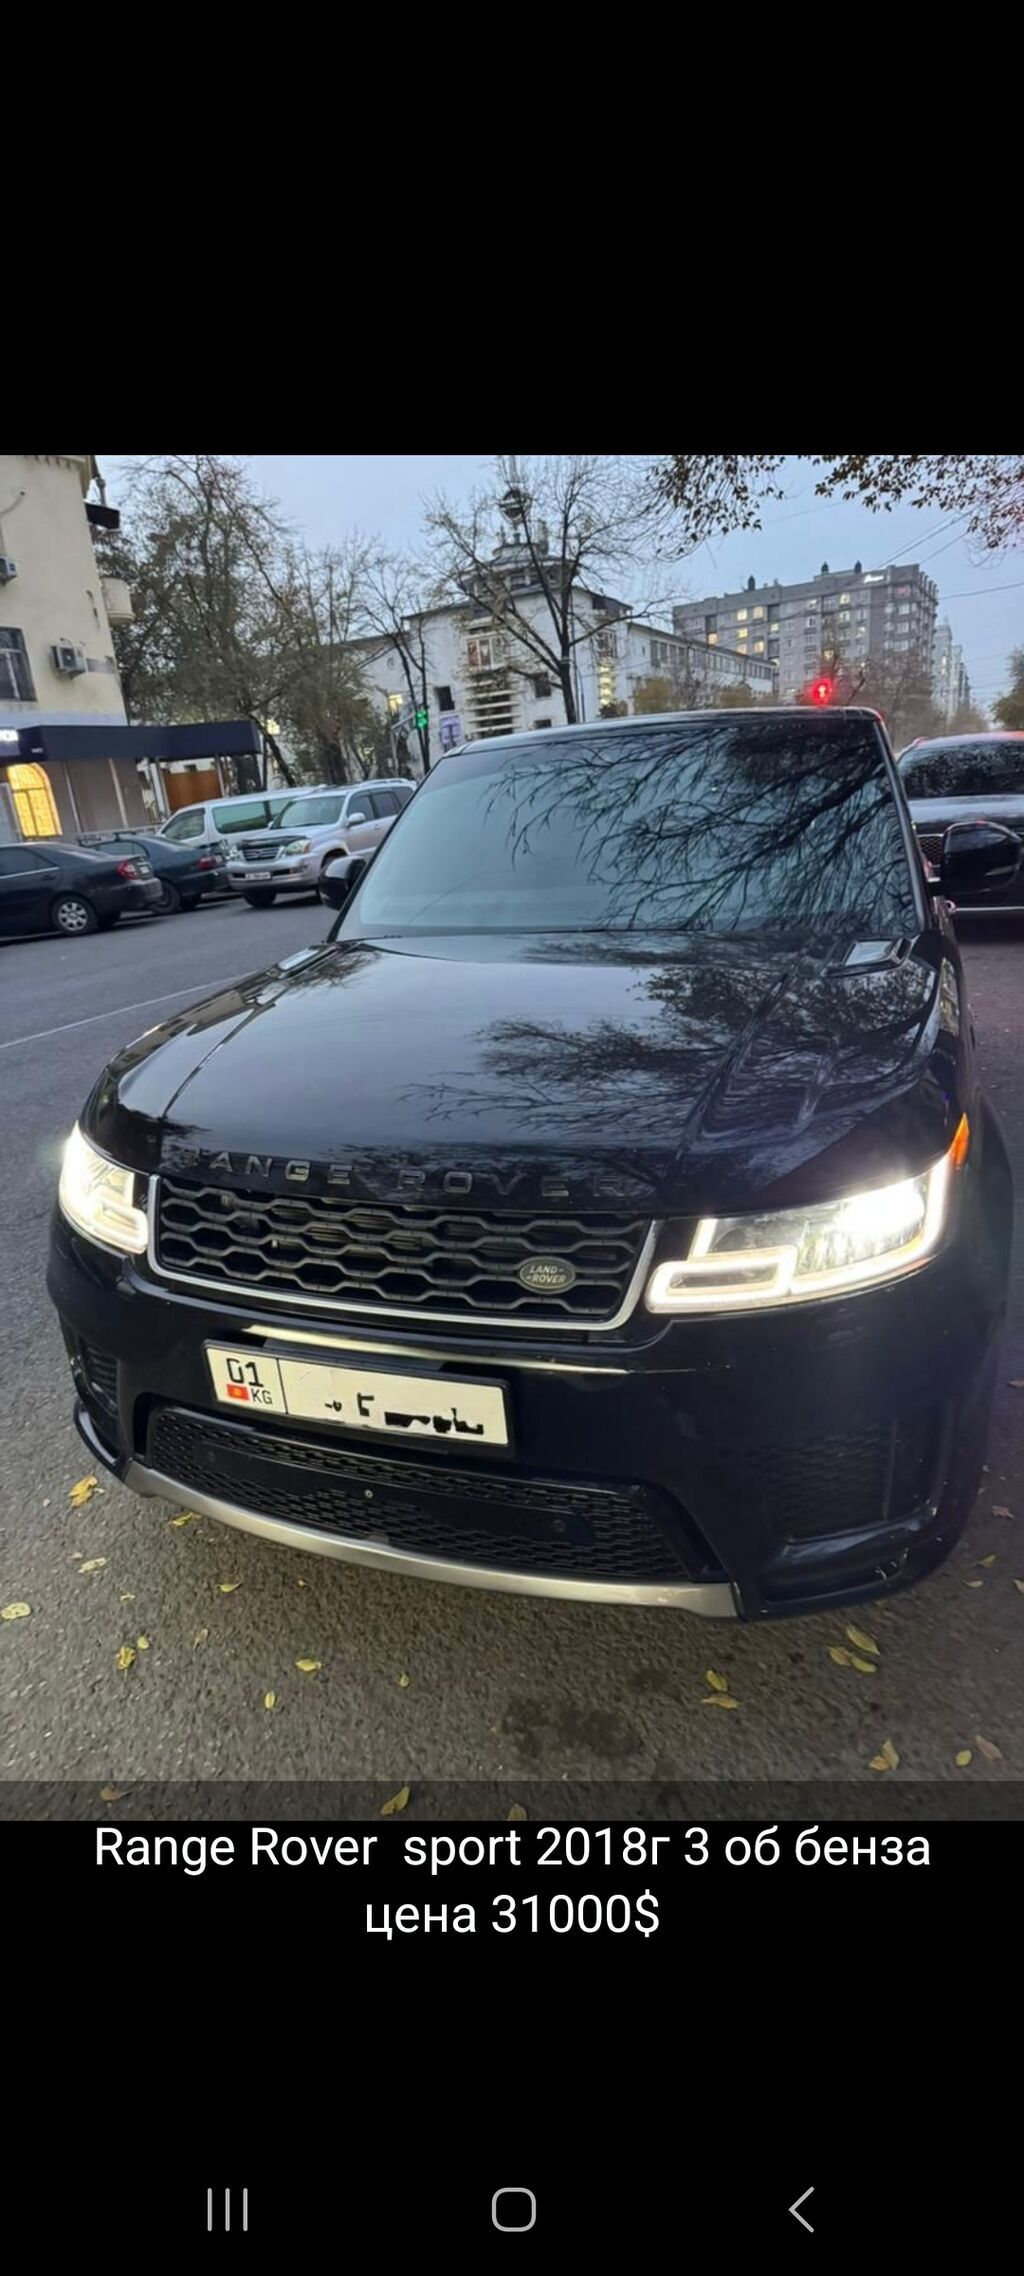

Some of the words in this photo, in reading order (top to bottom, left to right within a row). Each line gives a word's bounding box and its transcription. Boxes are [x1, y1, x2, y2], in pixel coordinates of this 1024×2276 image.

[398, 1169, 626, 1197] ROVER
[226, 1357, 264, 1387] 01
[250, 1387, 273, 1405] KG
